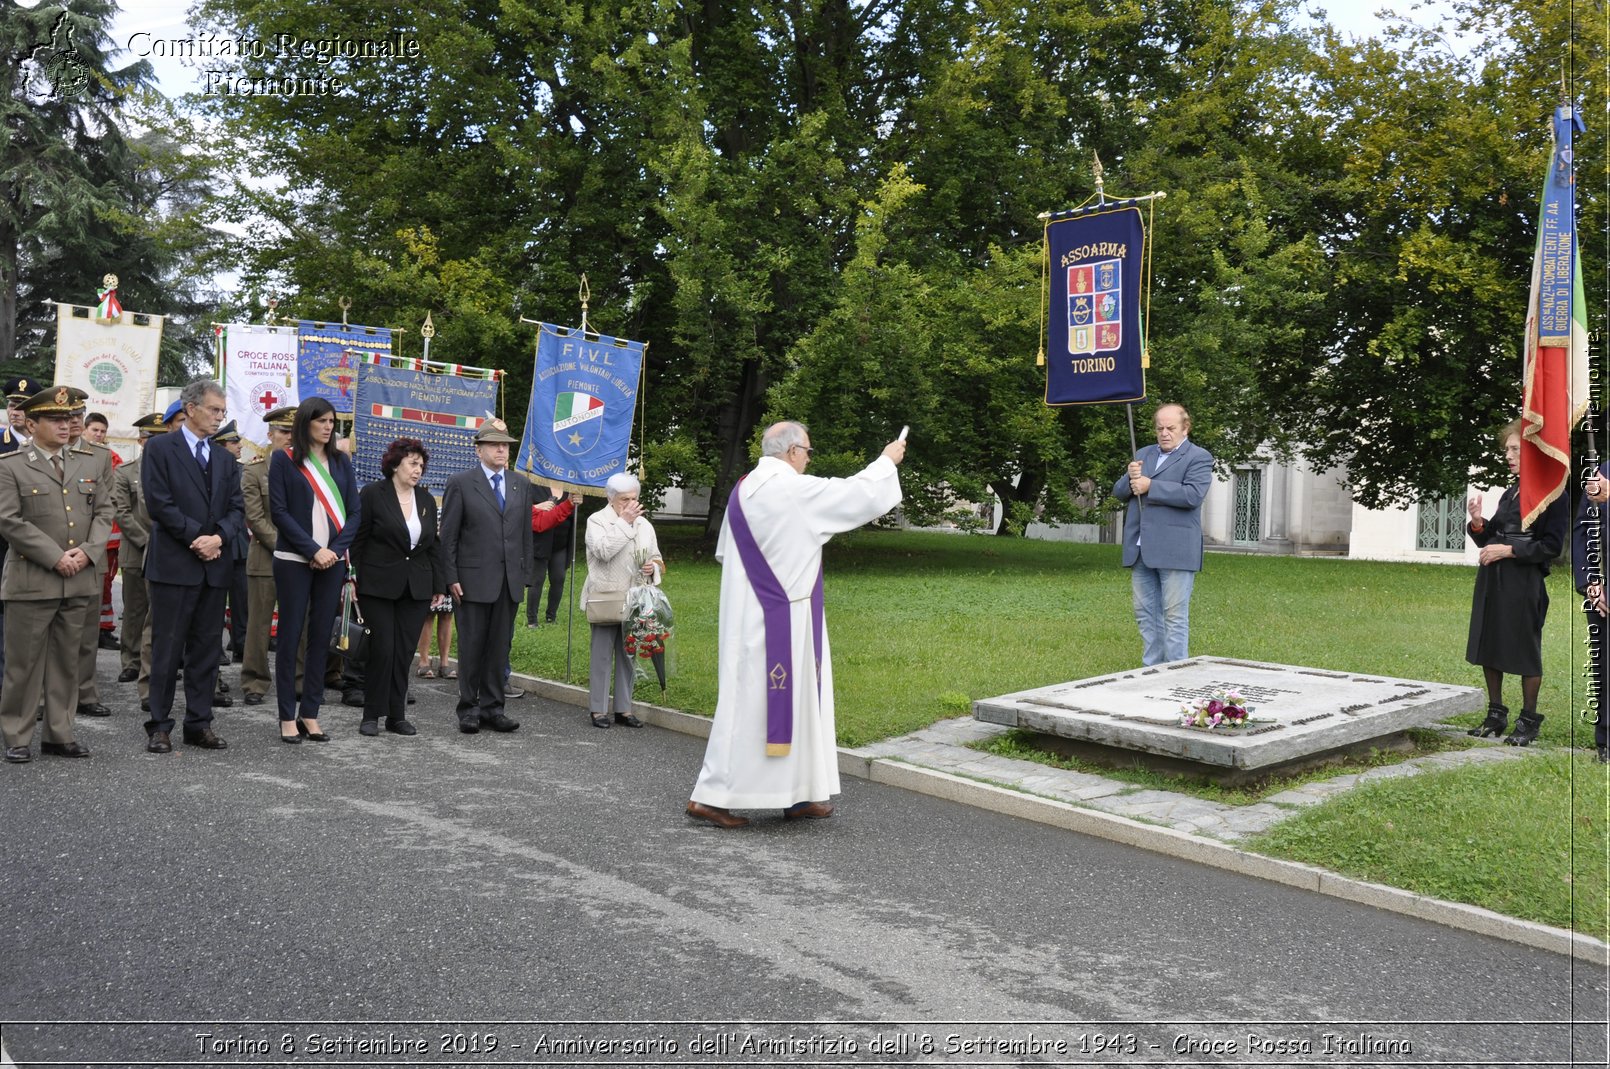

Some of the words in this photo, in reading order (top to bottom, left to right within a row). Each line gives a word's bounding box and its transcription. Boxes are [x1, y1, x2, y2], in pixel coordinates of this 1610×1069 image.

[1061, 242, 1127, 268] ASSOARMA
[1544, 232, 1557, 285] COMBATTENTI
[1558, 232, 1571, 284] LIBERAZIONE
[1557, 288, 1568, 296] DI
[1555, 300, 1568, 331] GUERRA
[237, 350, 268, 360] CROCE
[272, 352, 297, 361] ROSS
[249, 361, 288, 370] ITALIANA
[1072, 357, 1115, 374] TORINO
[365, 375, 409, 388] ASSOCIAZIONE
[410, 381, 441, 394] NAZIONALE
[567, 380, 600, 394] PIEMONTE
[410, 391, 452, 405] PIEMONTE
[567, 470, 579, 480] DI
[583, 458, 620, 479] TORINO
